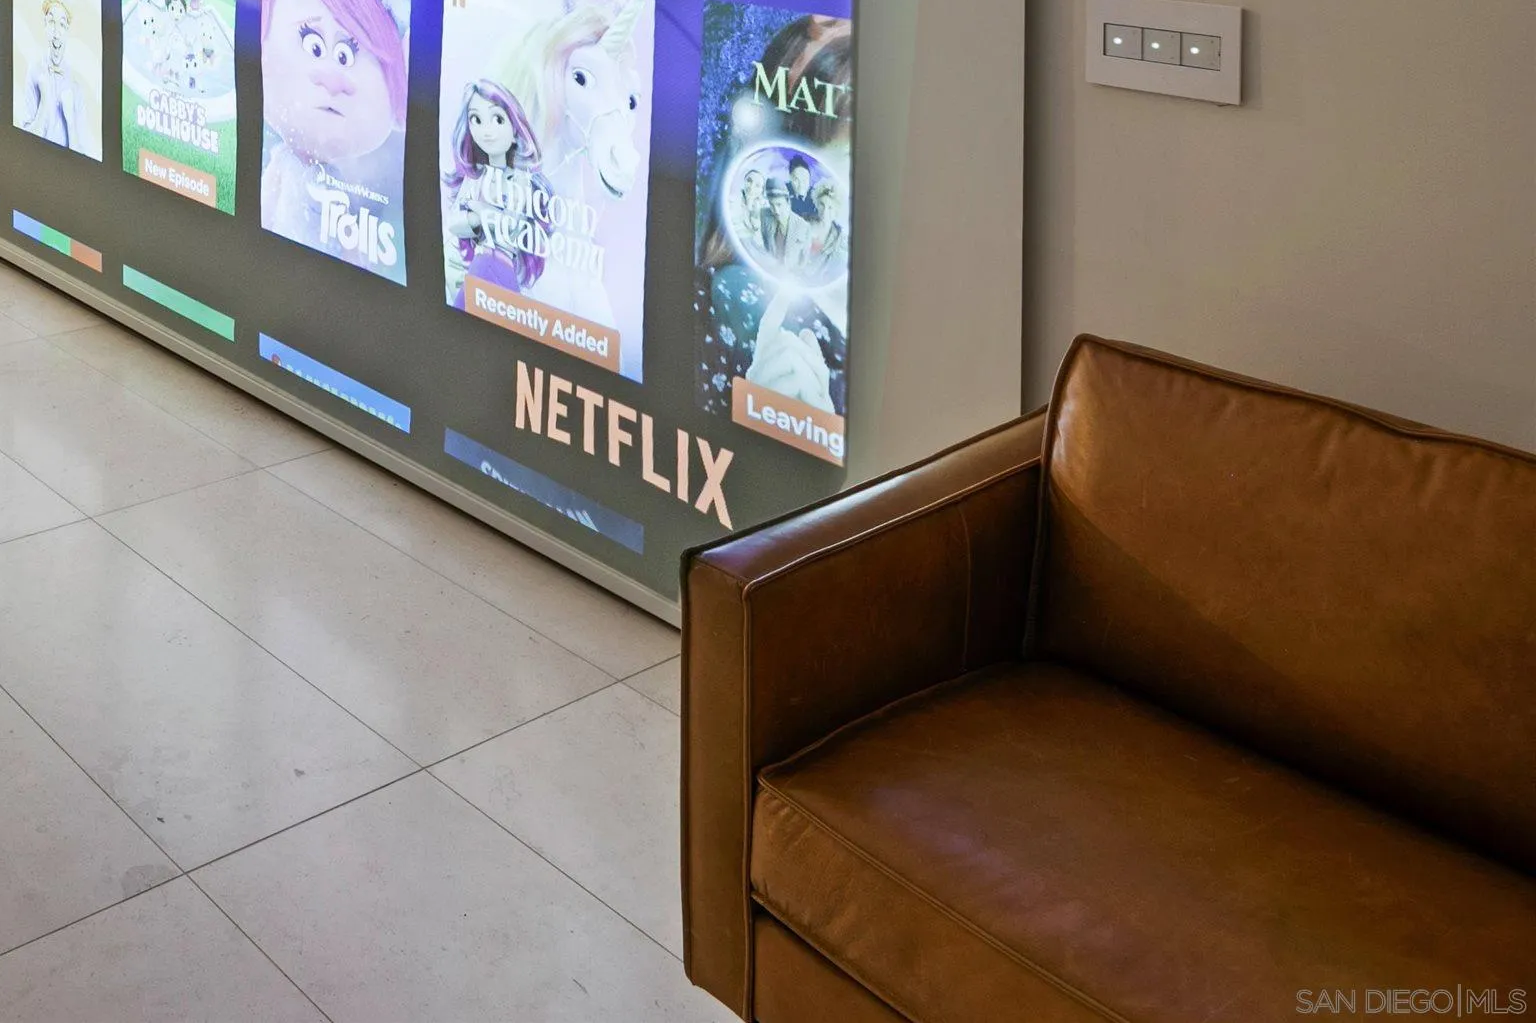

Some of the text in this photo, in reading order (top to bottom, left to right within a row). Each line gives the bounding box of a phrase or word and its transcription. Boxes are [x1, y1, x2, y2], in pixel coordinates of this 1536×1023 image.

[137, 104, 219, 154] DOLLHOUSE
[144, 158, 210, 197] New Episode
[474, 287, 609, 357] Recently Added
[515, 360, 735, 531] NETFLIX
[746, 393, 845, 458] Leaving
